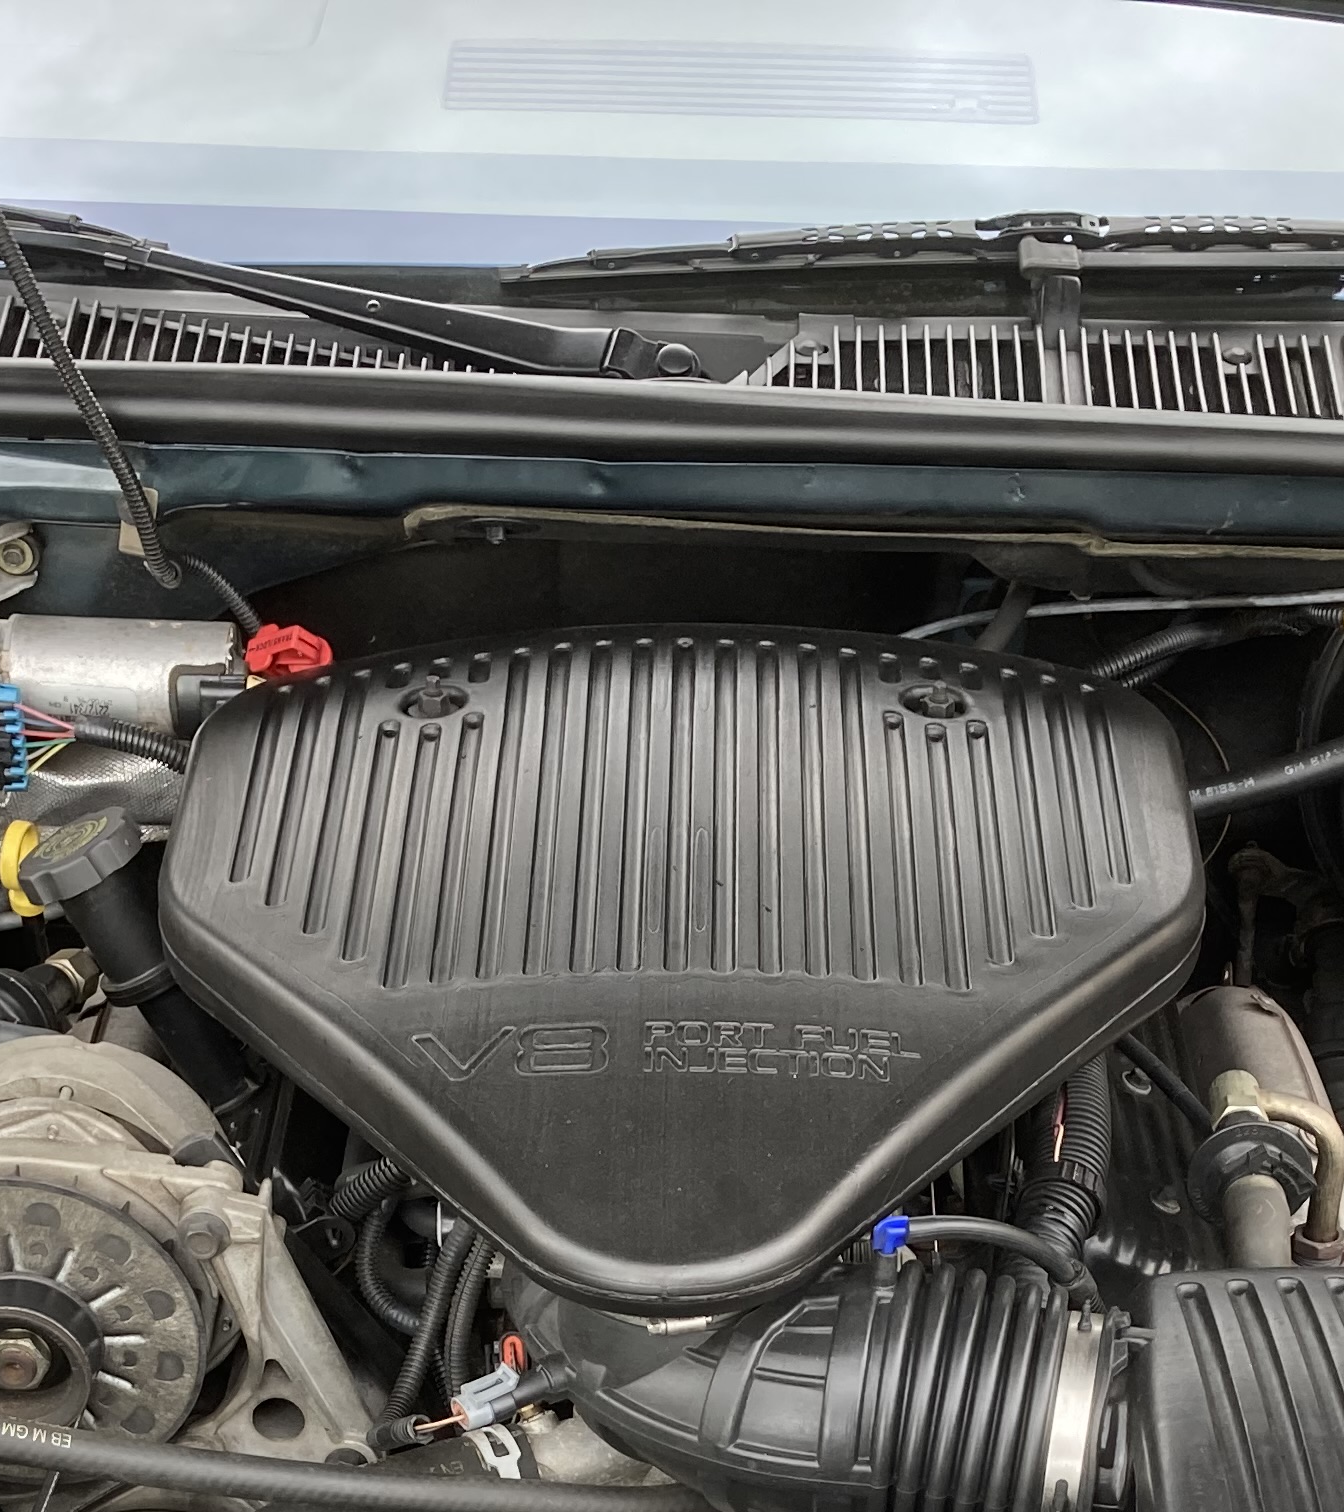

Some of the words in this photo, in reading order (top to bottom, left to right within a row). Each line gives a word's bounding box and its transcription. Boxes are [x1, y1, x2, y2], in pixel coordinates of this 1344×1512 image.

[411, 1022, 610, 1081] V8
[643, 1021, 776, 1047] PORT
[794, 1025, 922, 1058] FUEL
[643, 1047, 891, 1081] INJECTION
[1, 1422, 28, 1439] GM
[32, 1428, 47, 1443] M
[51, 1432, 71, 1449] EB
